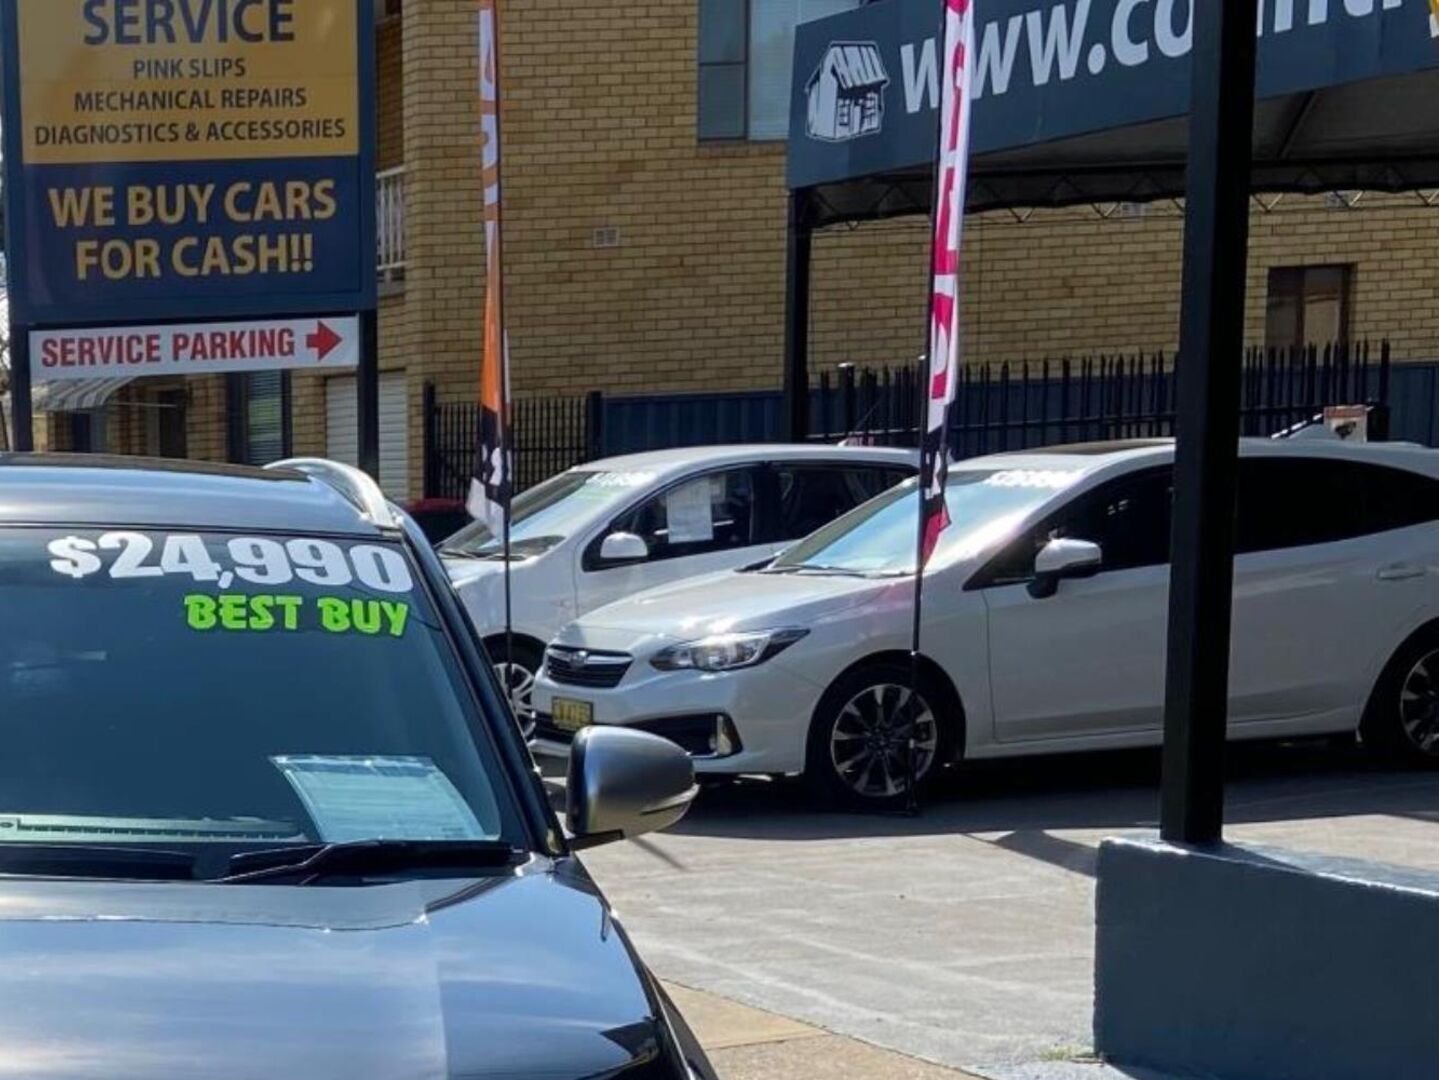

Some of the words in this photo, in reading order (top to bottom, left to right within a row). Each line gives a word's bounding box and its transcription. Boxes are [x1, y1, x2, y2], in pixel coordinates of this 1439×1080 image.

[83, 0, 295, 44] SERVICE
[133, 59, 183, 79] PINK
[189, 57, 246, 77] SLIPS
[74, 90, 215, 112] MECHANICAL
[221, 87, 307, 108] REPAIRS
[34, 122, 178, 146] DIAGNOSTICS
[184, 122, 200, 141] &
[206, 118, 346, 141] ACCESSORIES
[48, 186, 116, 228] WE
[127, 183, 215, 226] BUY
[223, 179, 337, 222] CARS
[76, 238, 161, 281] FOR
[171, 232, 314, 277] CASH!!
[41, 333, 161, 368] SERVICE
[172, 327, 295, 362] PARKING
[47, 531, 414, 593] $24,990
[184, 593, 302, 631] BEST
[317, 598, 409, 636] BUY
